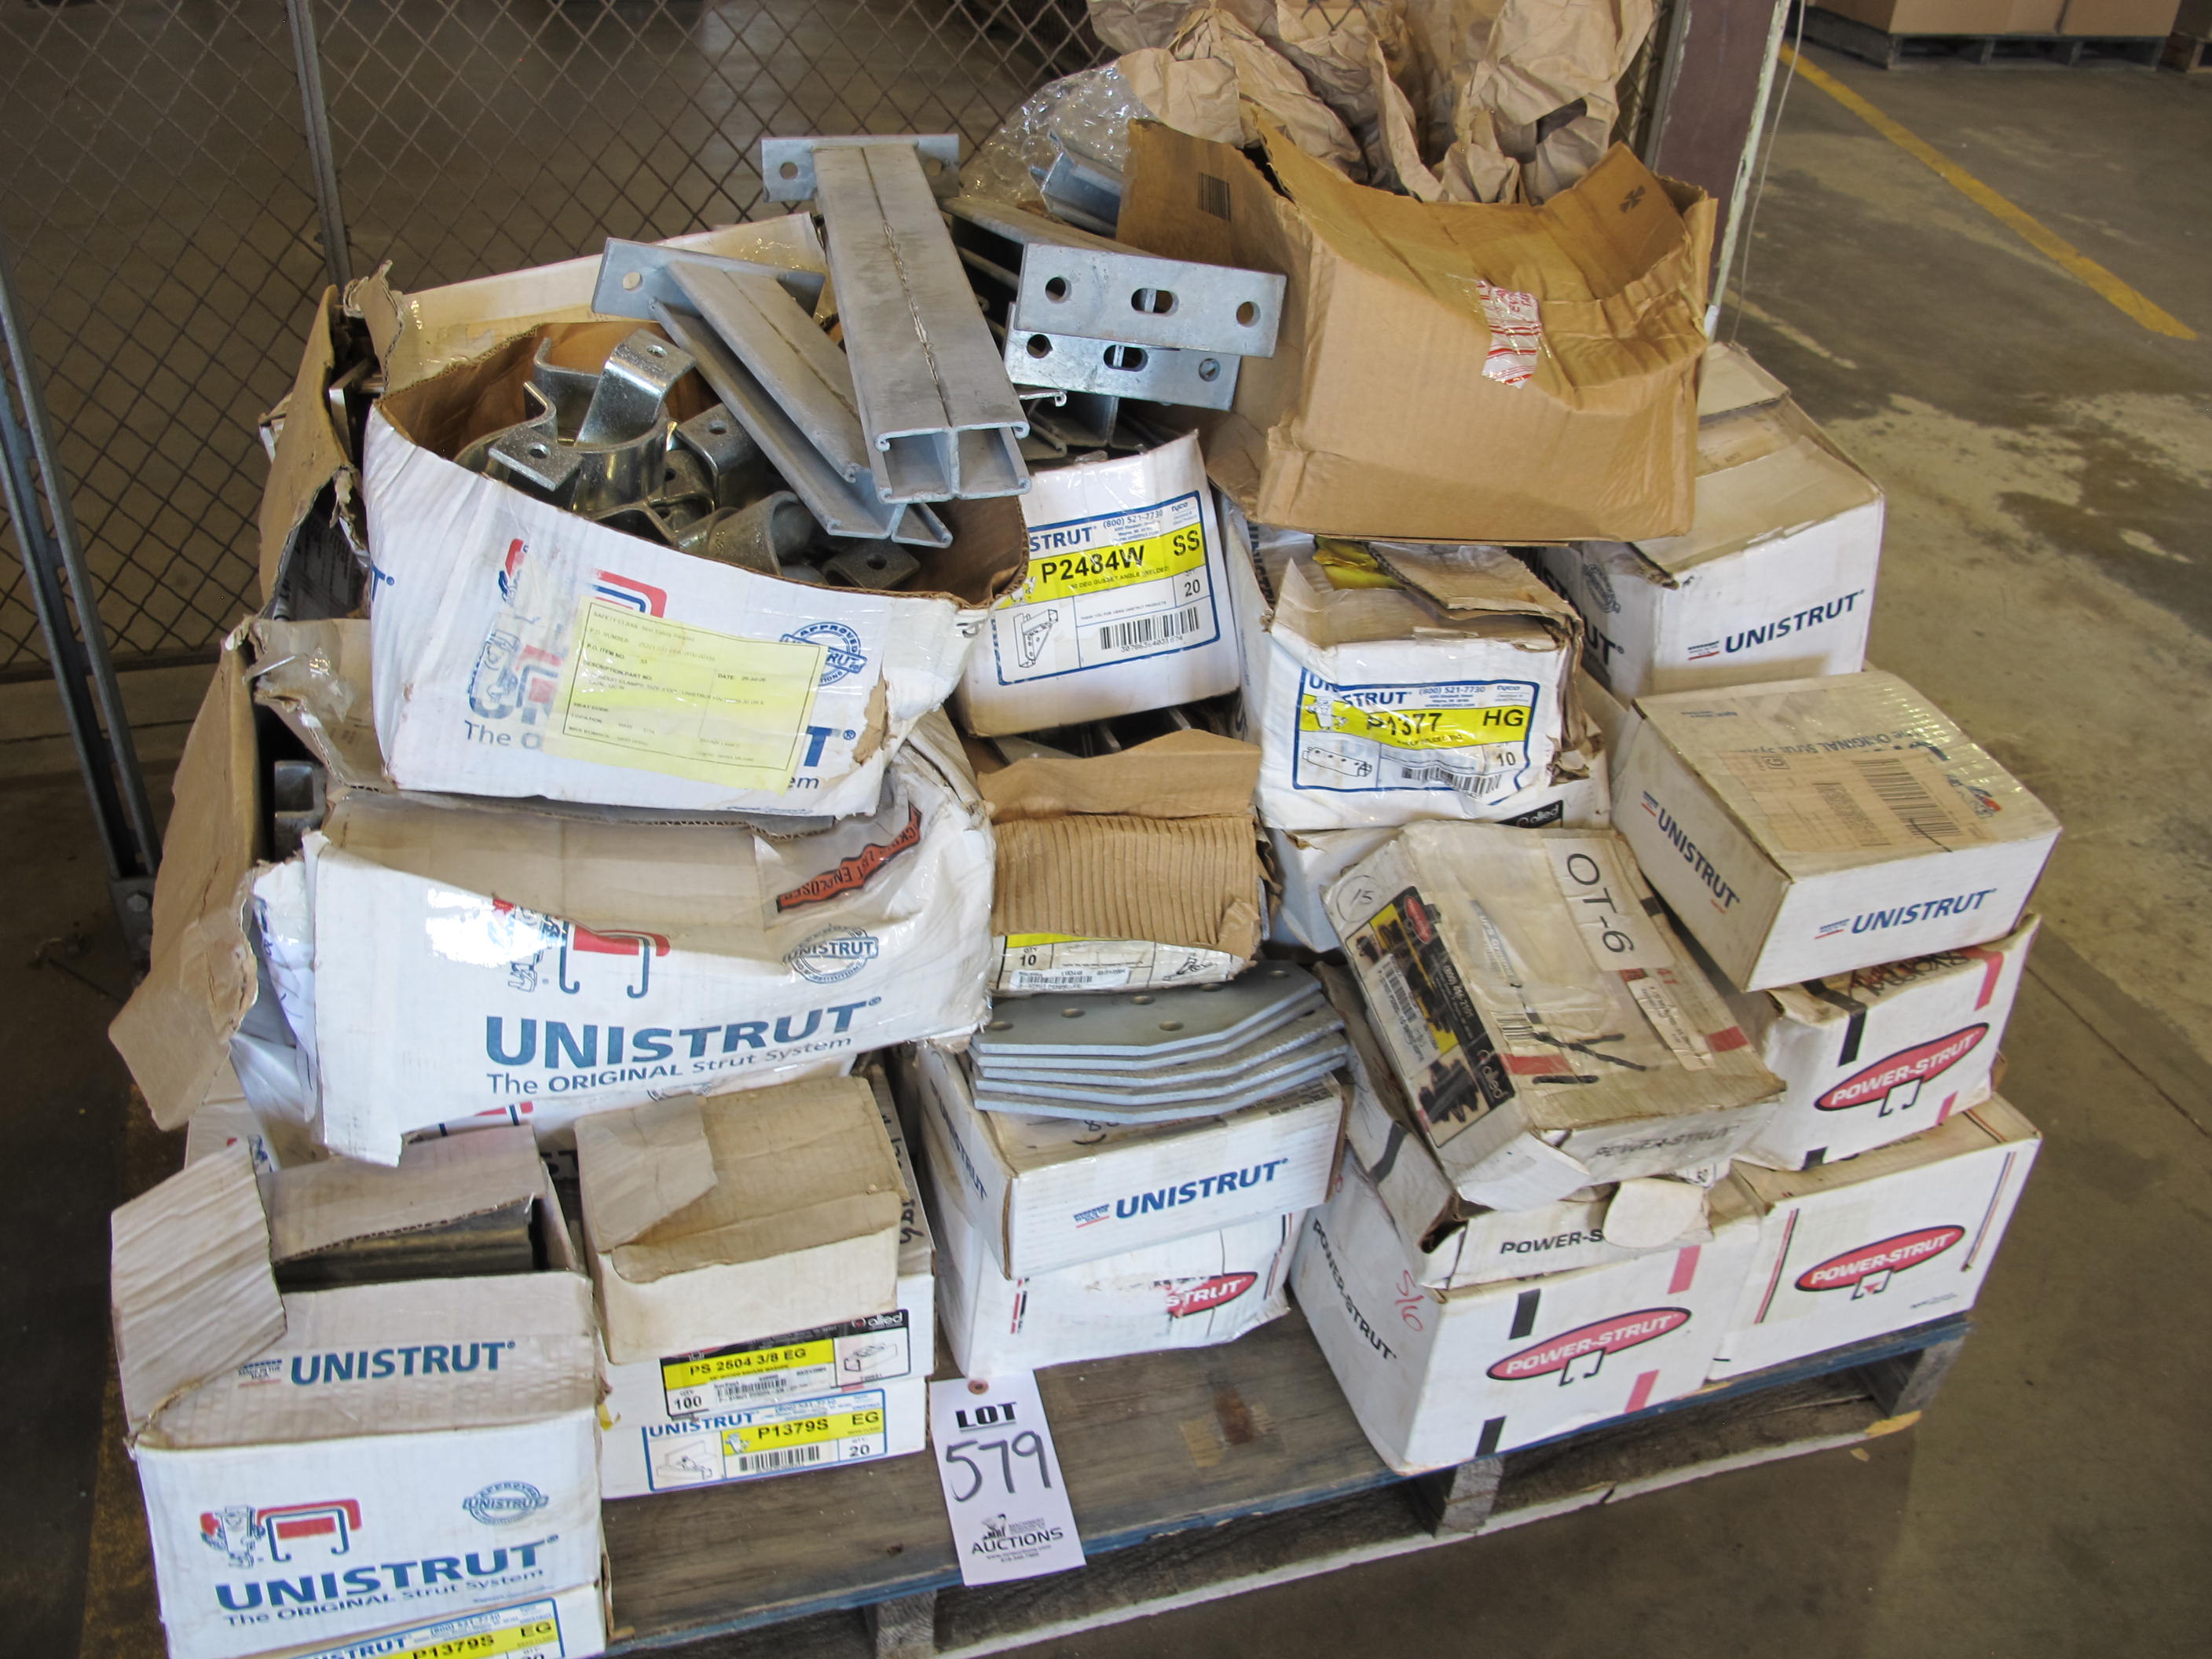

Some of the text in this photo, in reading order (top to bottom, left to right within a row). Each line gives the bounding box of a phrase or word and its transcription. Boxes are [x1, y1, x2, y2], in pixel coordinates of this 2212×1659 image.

[1103, 516, 1125, 529] (800)
[1030, 526, 1093, 552] STRUT
[1173, 530, 1200, 557] SS
[1042, 545, 1144, 584] P2484W
[1185, 579, 1200, 597] 20
[1444, 685, 1485, 695] 521-7730
[1366, 712, 1443, 737] P1377
[1483, 709, 1525, 728] HG
[464, 720, 511, 746] The
[1496, 751, 1517, 767] 10
[1567, 853, 1635, 952] OT-6
[1020, 954, 1036, 966] 10
[487, 1036, 852, 1095] The ORIGINAL Strut System
[1831, 1034, 1975, 1104] POWER-STRUT
[1500, 1229, 1604, 1254] POWER-S
[1811, 1234, 1953, 1284] POWER-STRUT
[1506, 1314, 1673, 1375] POWER-STRUT
[690, 1364, 711, 1375] PS
[757, 1353, 778, 1365] 3/8
[785, 1348, 807, 1361] EG
[675, 1397, 701, 1411] 100
[955, 1402, 1016, 1428] LOT
[758, 1418, 829, 1440] P1379S
[851, 1412, 879, 1426] EG
[849, 1445, 870, 1457] 20
[946, 1430, 1052, 1503] 579
[972, 1527, 1064, 1554] AUCTIONS
[226, 1569, 544, 1627] The ORIGINAL Strut System
[521, 1621, 551, 1637] EG
